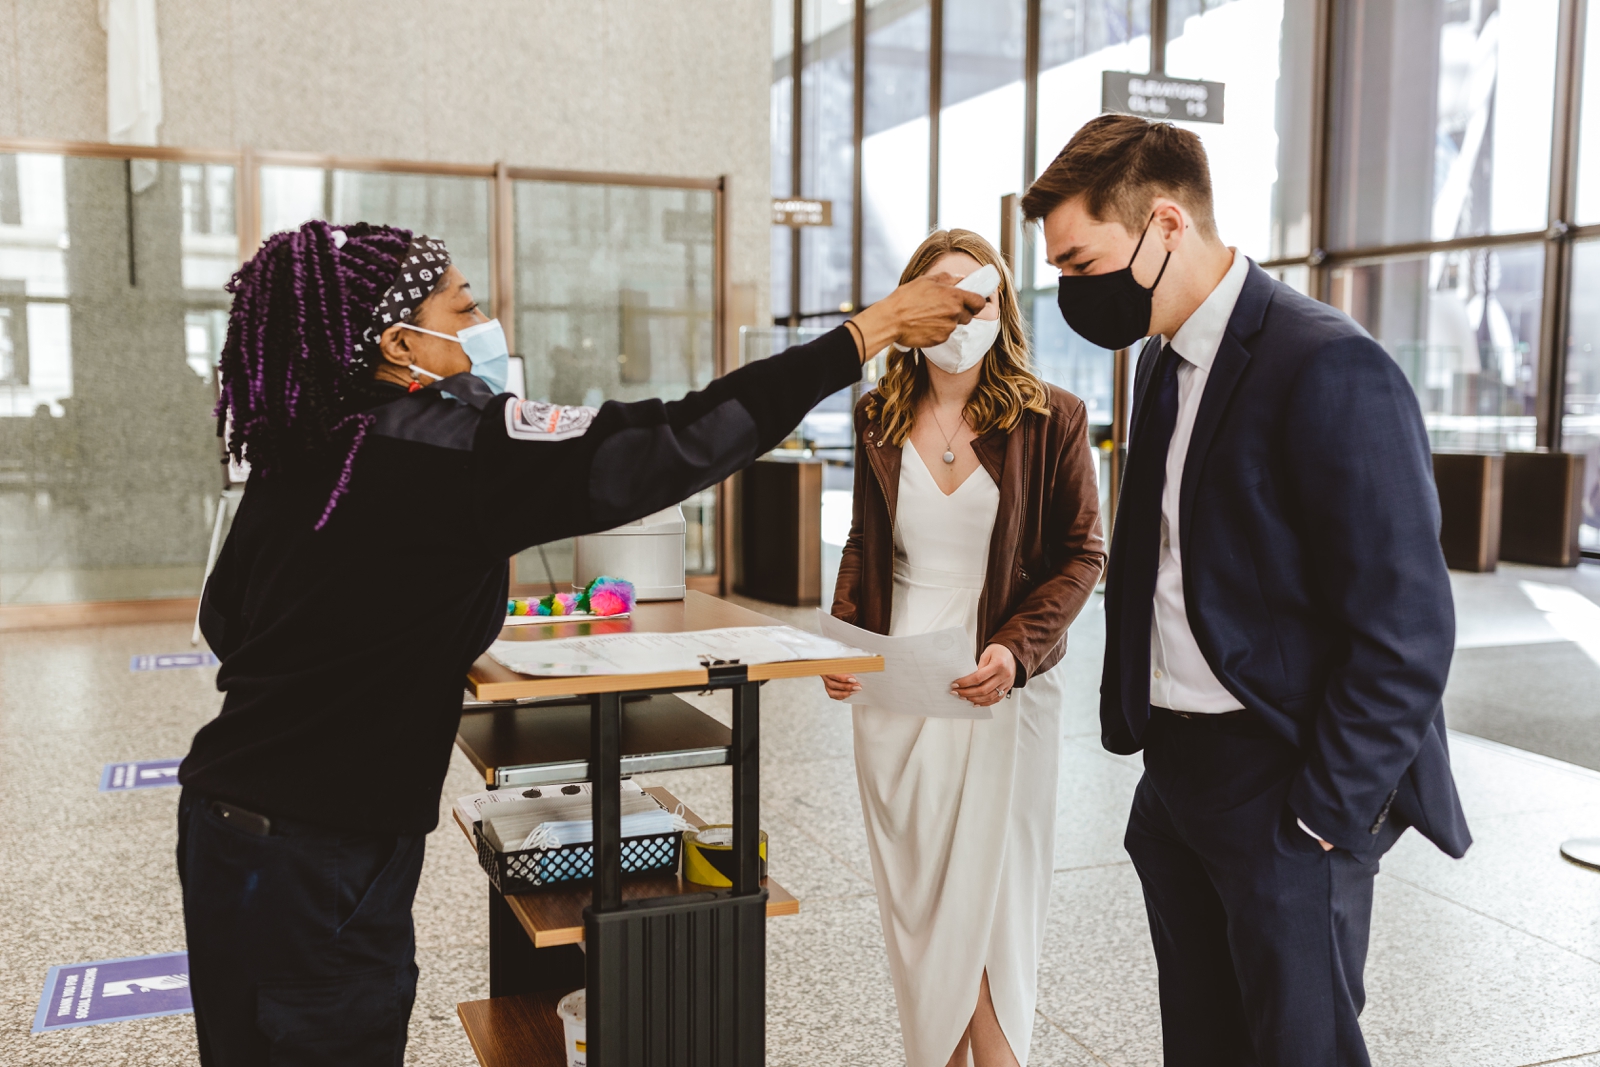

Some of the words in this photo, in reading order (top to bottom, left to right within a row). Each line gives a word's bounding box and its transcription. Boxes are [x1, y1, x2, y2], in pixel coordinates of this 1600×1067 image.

[62, 985, 76, 997] YOU
[79, 967, 97, 998] DISTANCING
[57, 997, 73, 1016] THANK
[75, 998, 91, 1019] SOCIAL
